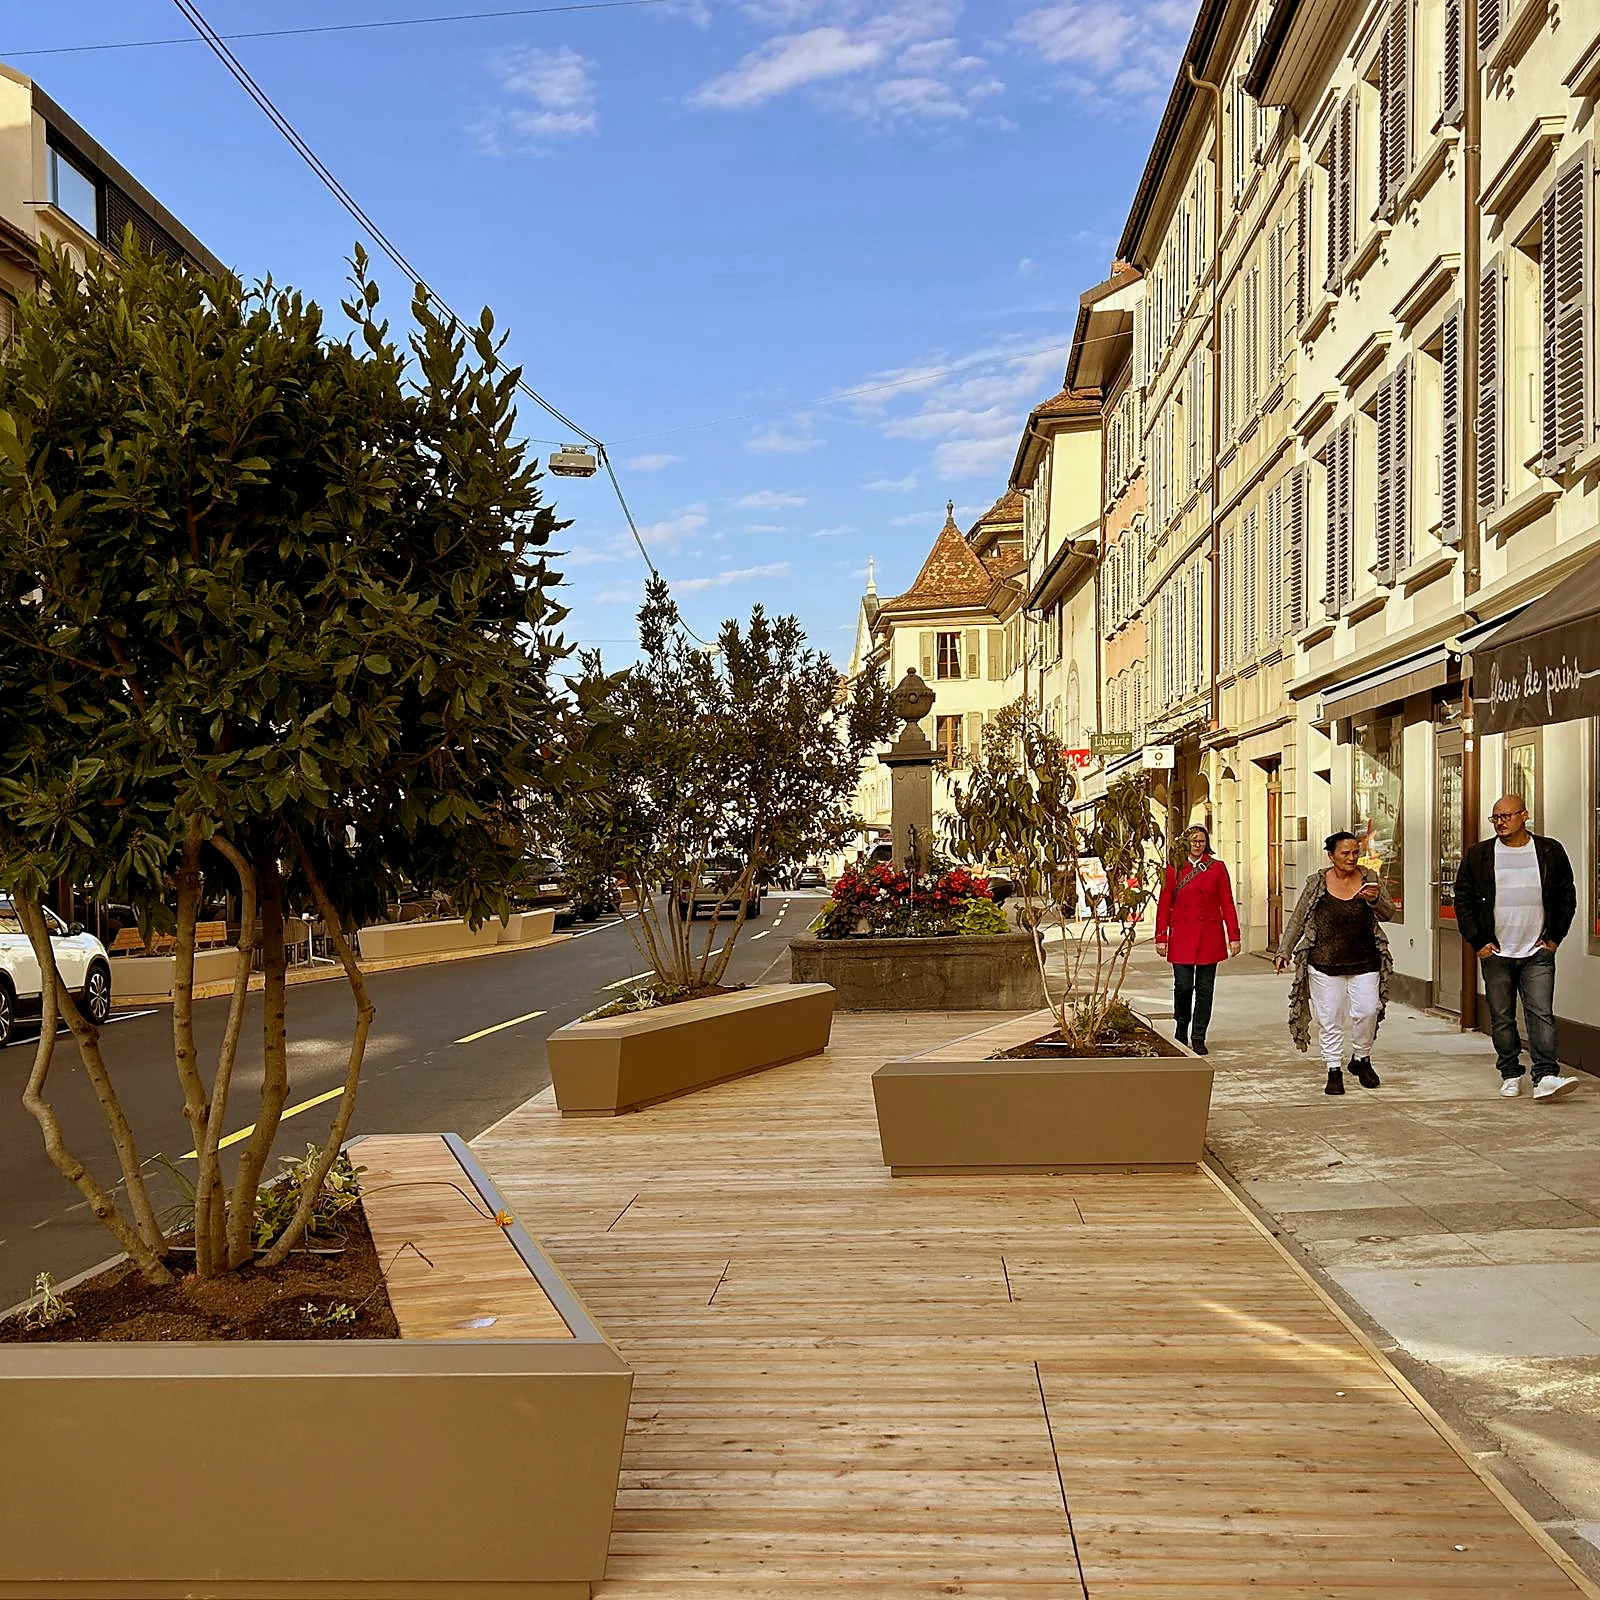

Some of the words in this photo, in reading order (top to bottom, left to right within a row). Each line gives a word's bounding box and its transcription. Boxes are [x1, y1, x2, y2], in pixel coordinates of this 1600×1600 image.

[1490, 661, 1521, 716] fleur
[1524, 655, 1542, 698] de
[1545, 655, 1581, 717] pains
[1095, 736, 1130, 747] Librairie
